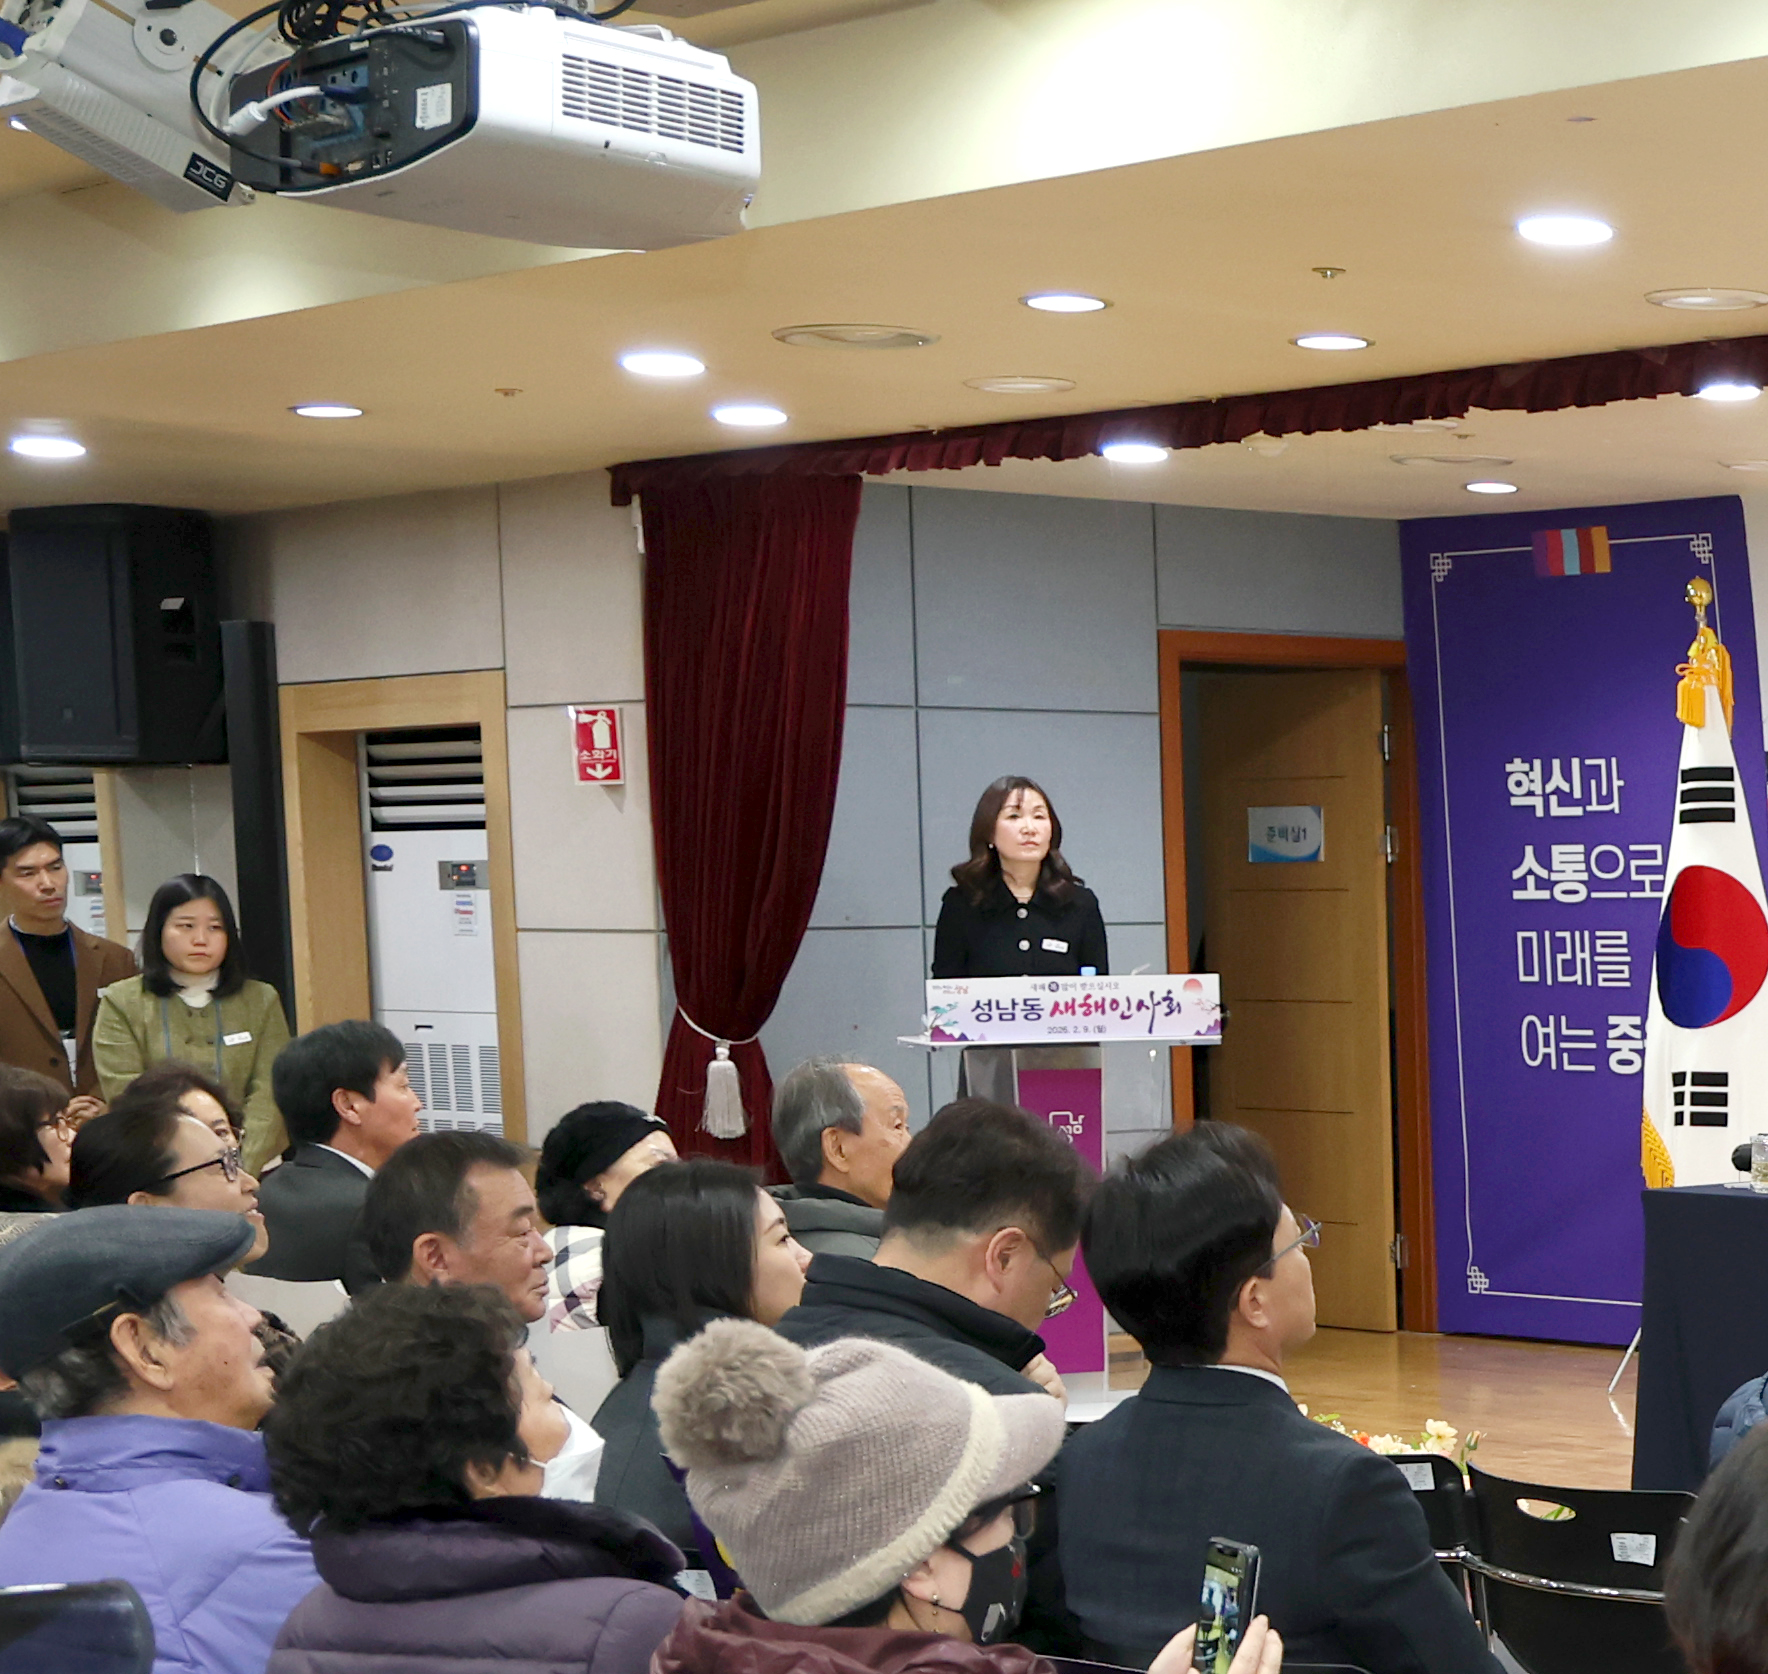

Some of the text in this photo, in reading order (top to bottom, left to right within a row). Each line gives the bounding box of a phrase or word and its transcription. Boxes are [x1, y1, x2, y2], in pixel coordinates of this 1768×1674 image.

[1505, 756, 1625, 818] 혁신과
[1512, 844, 1666, 904] 소통으로
[1516, 930, 1632, 988] 미래를
[971, 989, 1182, 1035] 성남동 새해인사회
[1521, 1014, 1648, 1076] 여는 중
